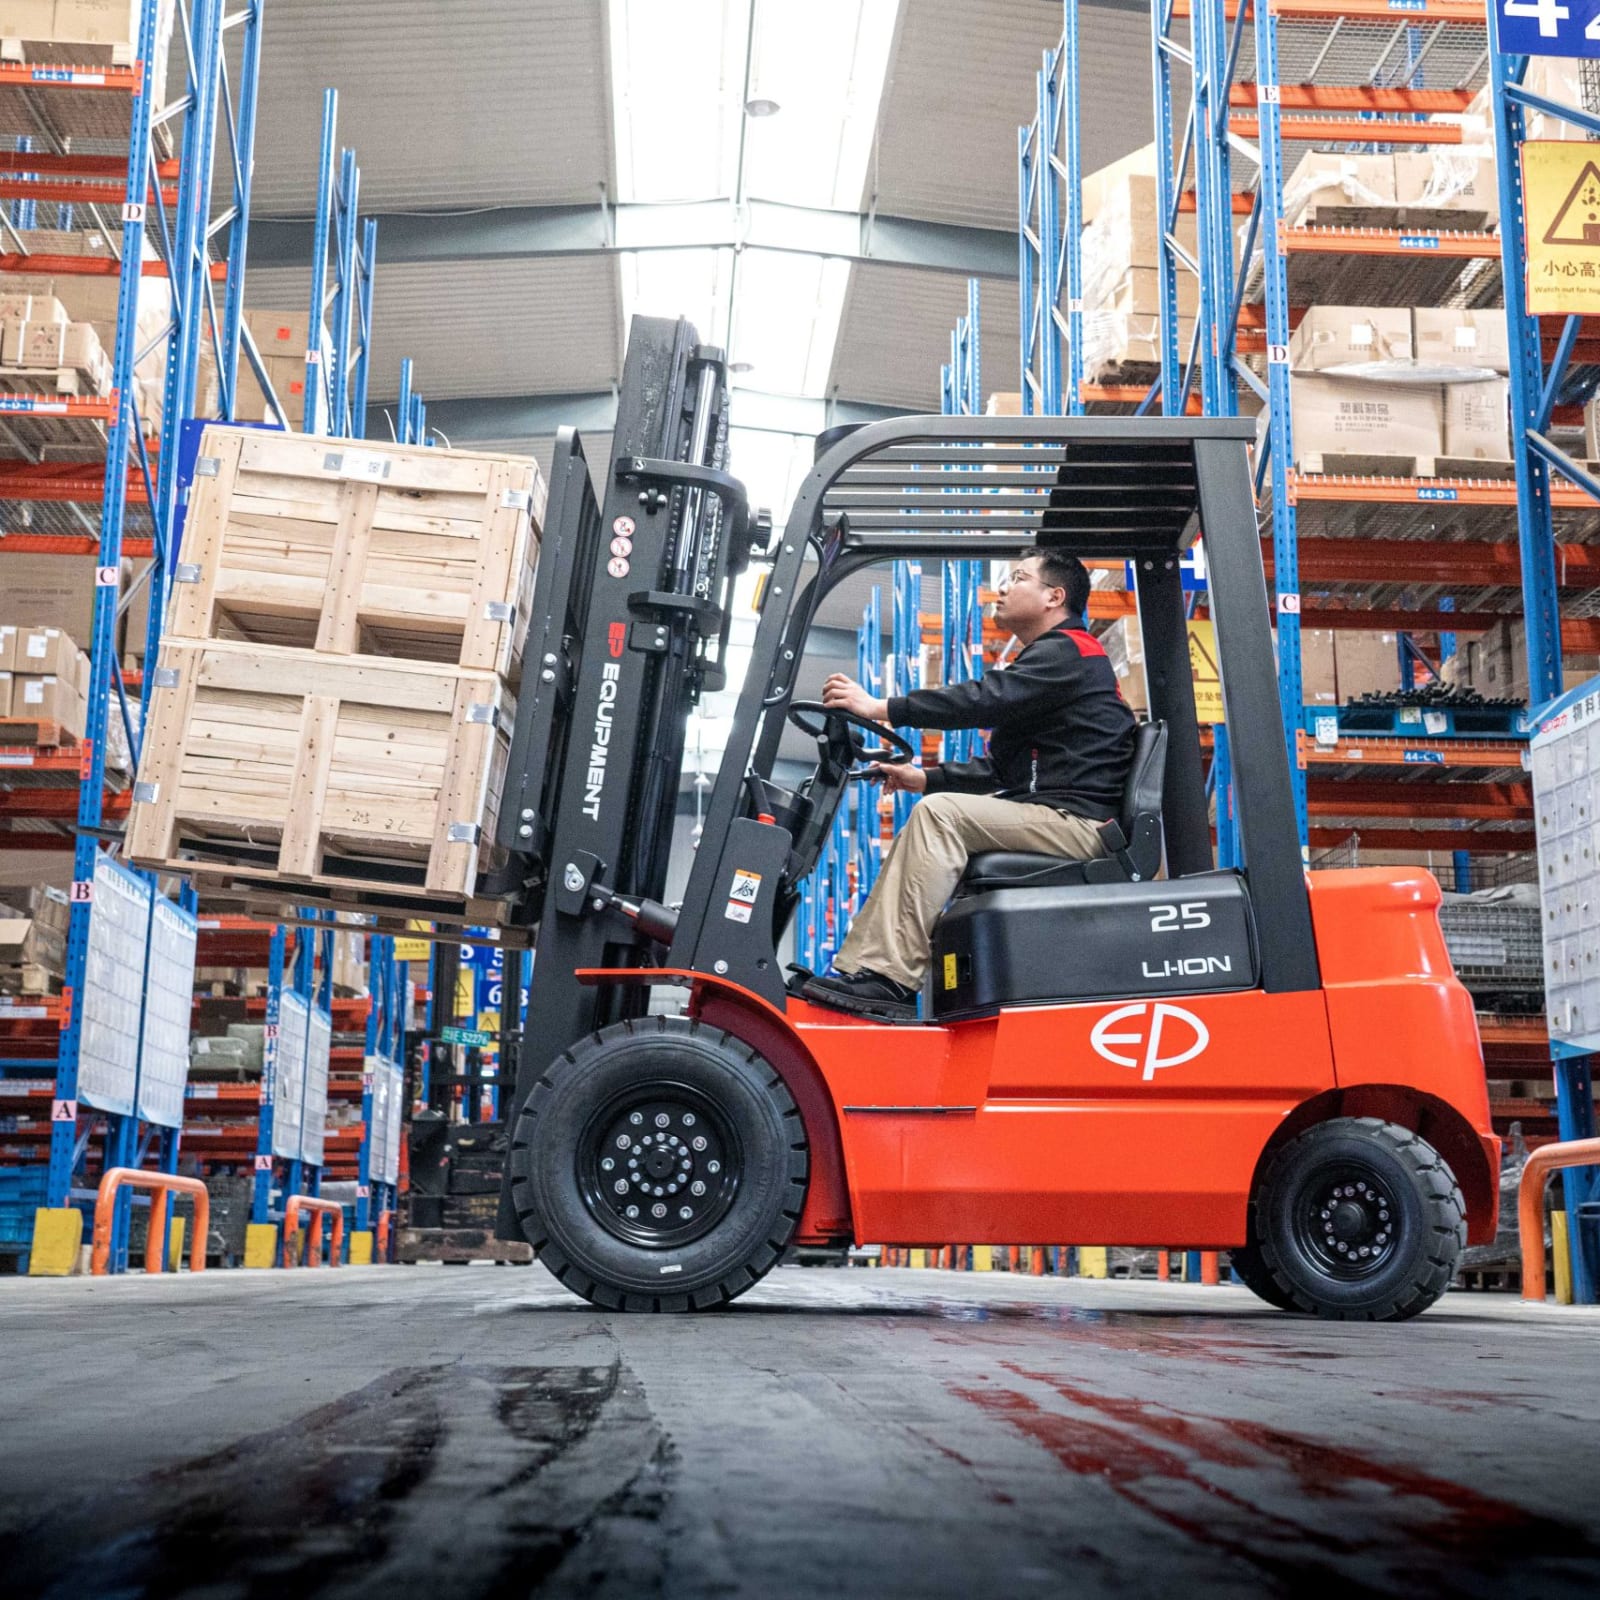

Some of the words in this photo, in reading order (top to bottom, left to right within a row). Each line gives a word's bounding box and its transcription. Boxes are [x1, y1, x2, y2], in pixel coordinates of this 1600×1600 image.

[1264, 87, 1277, 101] E
[126, 205, 142, 219] D
[1543, 260, 1600, 278] 小心高
[1272, 347, 1286, 361] D
[1418, 490, 1456, 499] 44-D-1
[100, 568, 115, 584] C
[1282, 595, 1297, 610] C
[1573, 693, 1600, 724] 物料
[583, 662, 621, 822] EQUIPMENT
[1404, 751, 1441, 761] 44-C-1
[75, 885, 91, 900] B
[1149, 902, 1211, 932] 25
[267, 1025, 278, 1037] B
[56, 1103, 72, 1119] A
[257, 1156, 270, 1169] A
